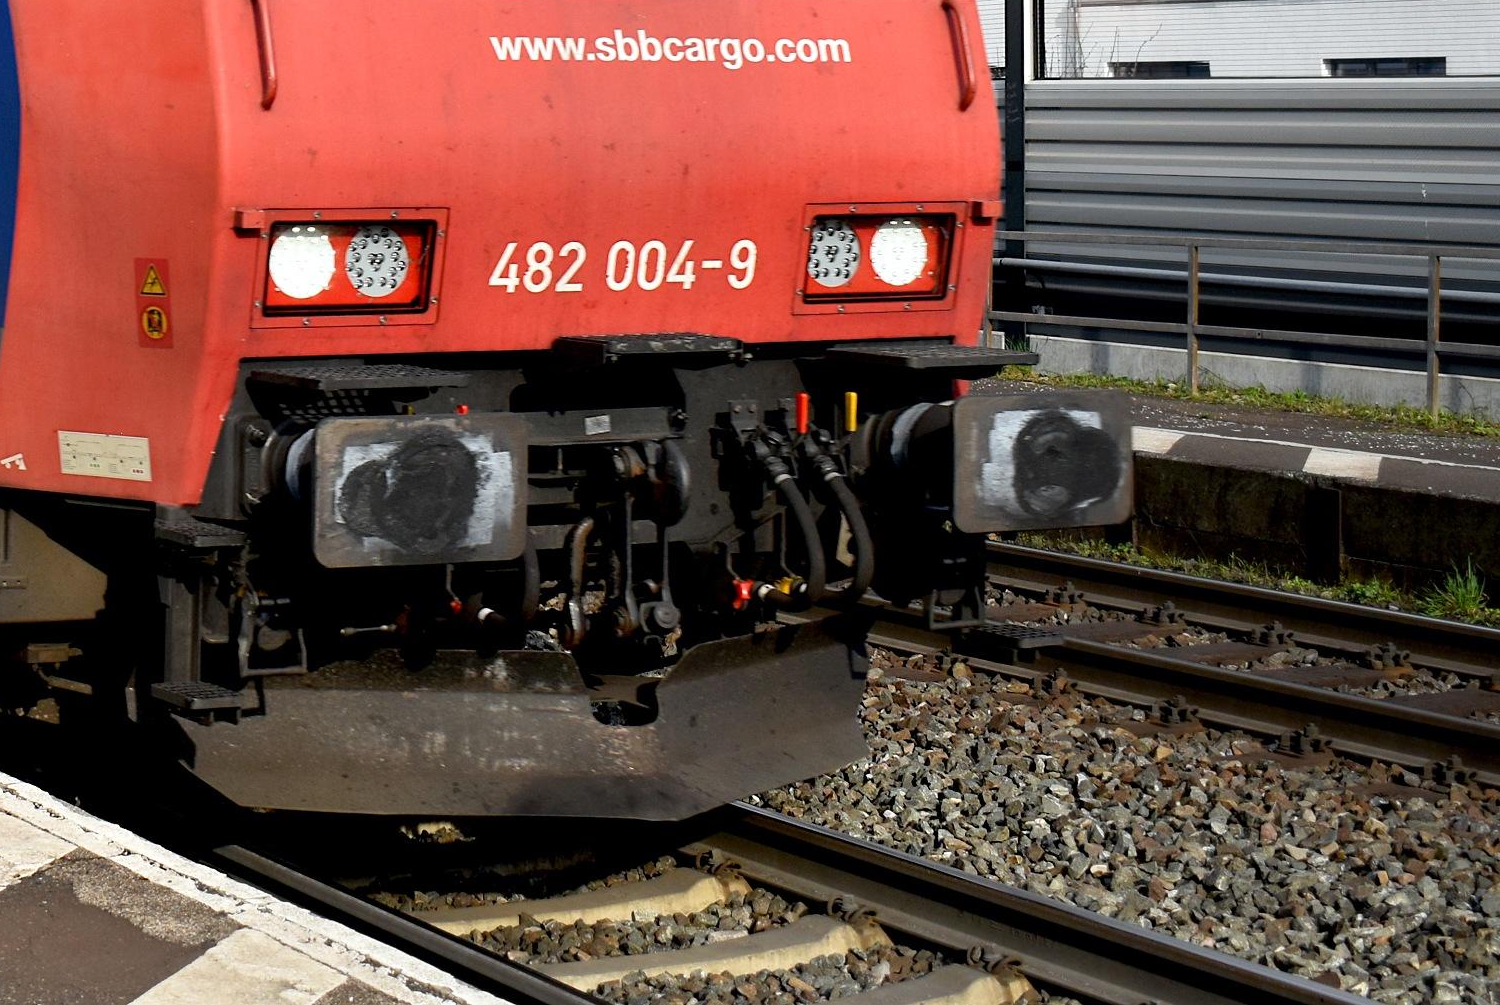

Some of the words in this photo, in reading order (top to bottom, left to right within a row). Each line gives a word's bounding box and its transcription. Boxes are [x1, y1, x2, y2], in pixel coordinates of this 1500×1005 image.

[489, 29, 852, 70] www.sbbcargo.com
[487, 241, 587, 293] 482
[605, 239, 758, 291] 004-9
